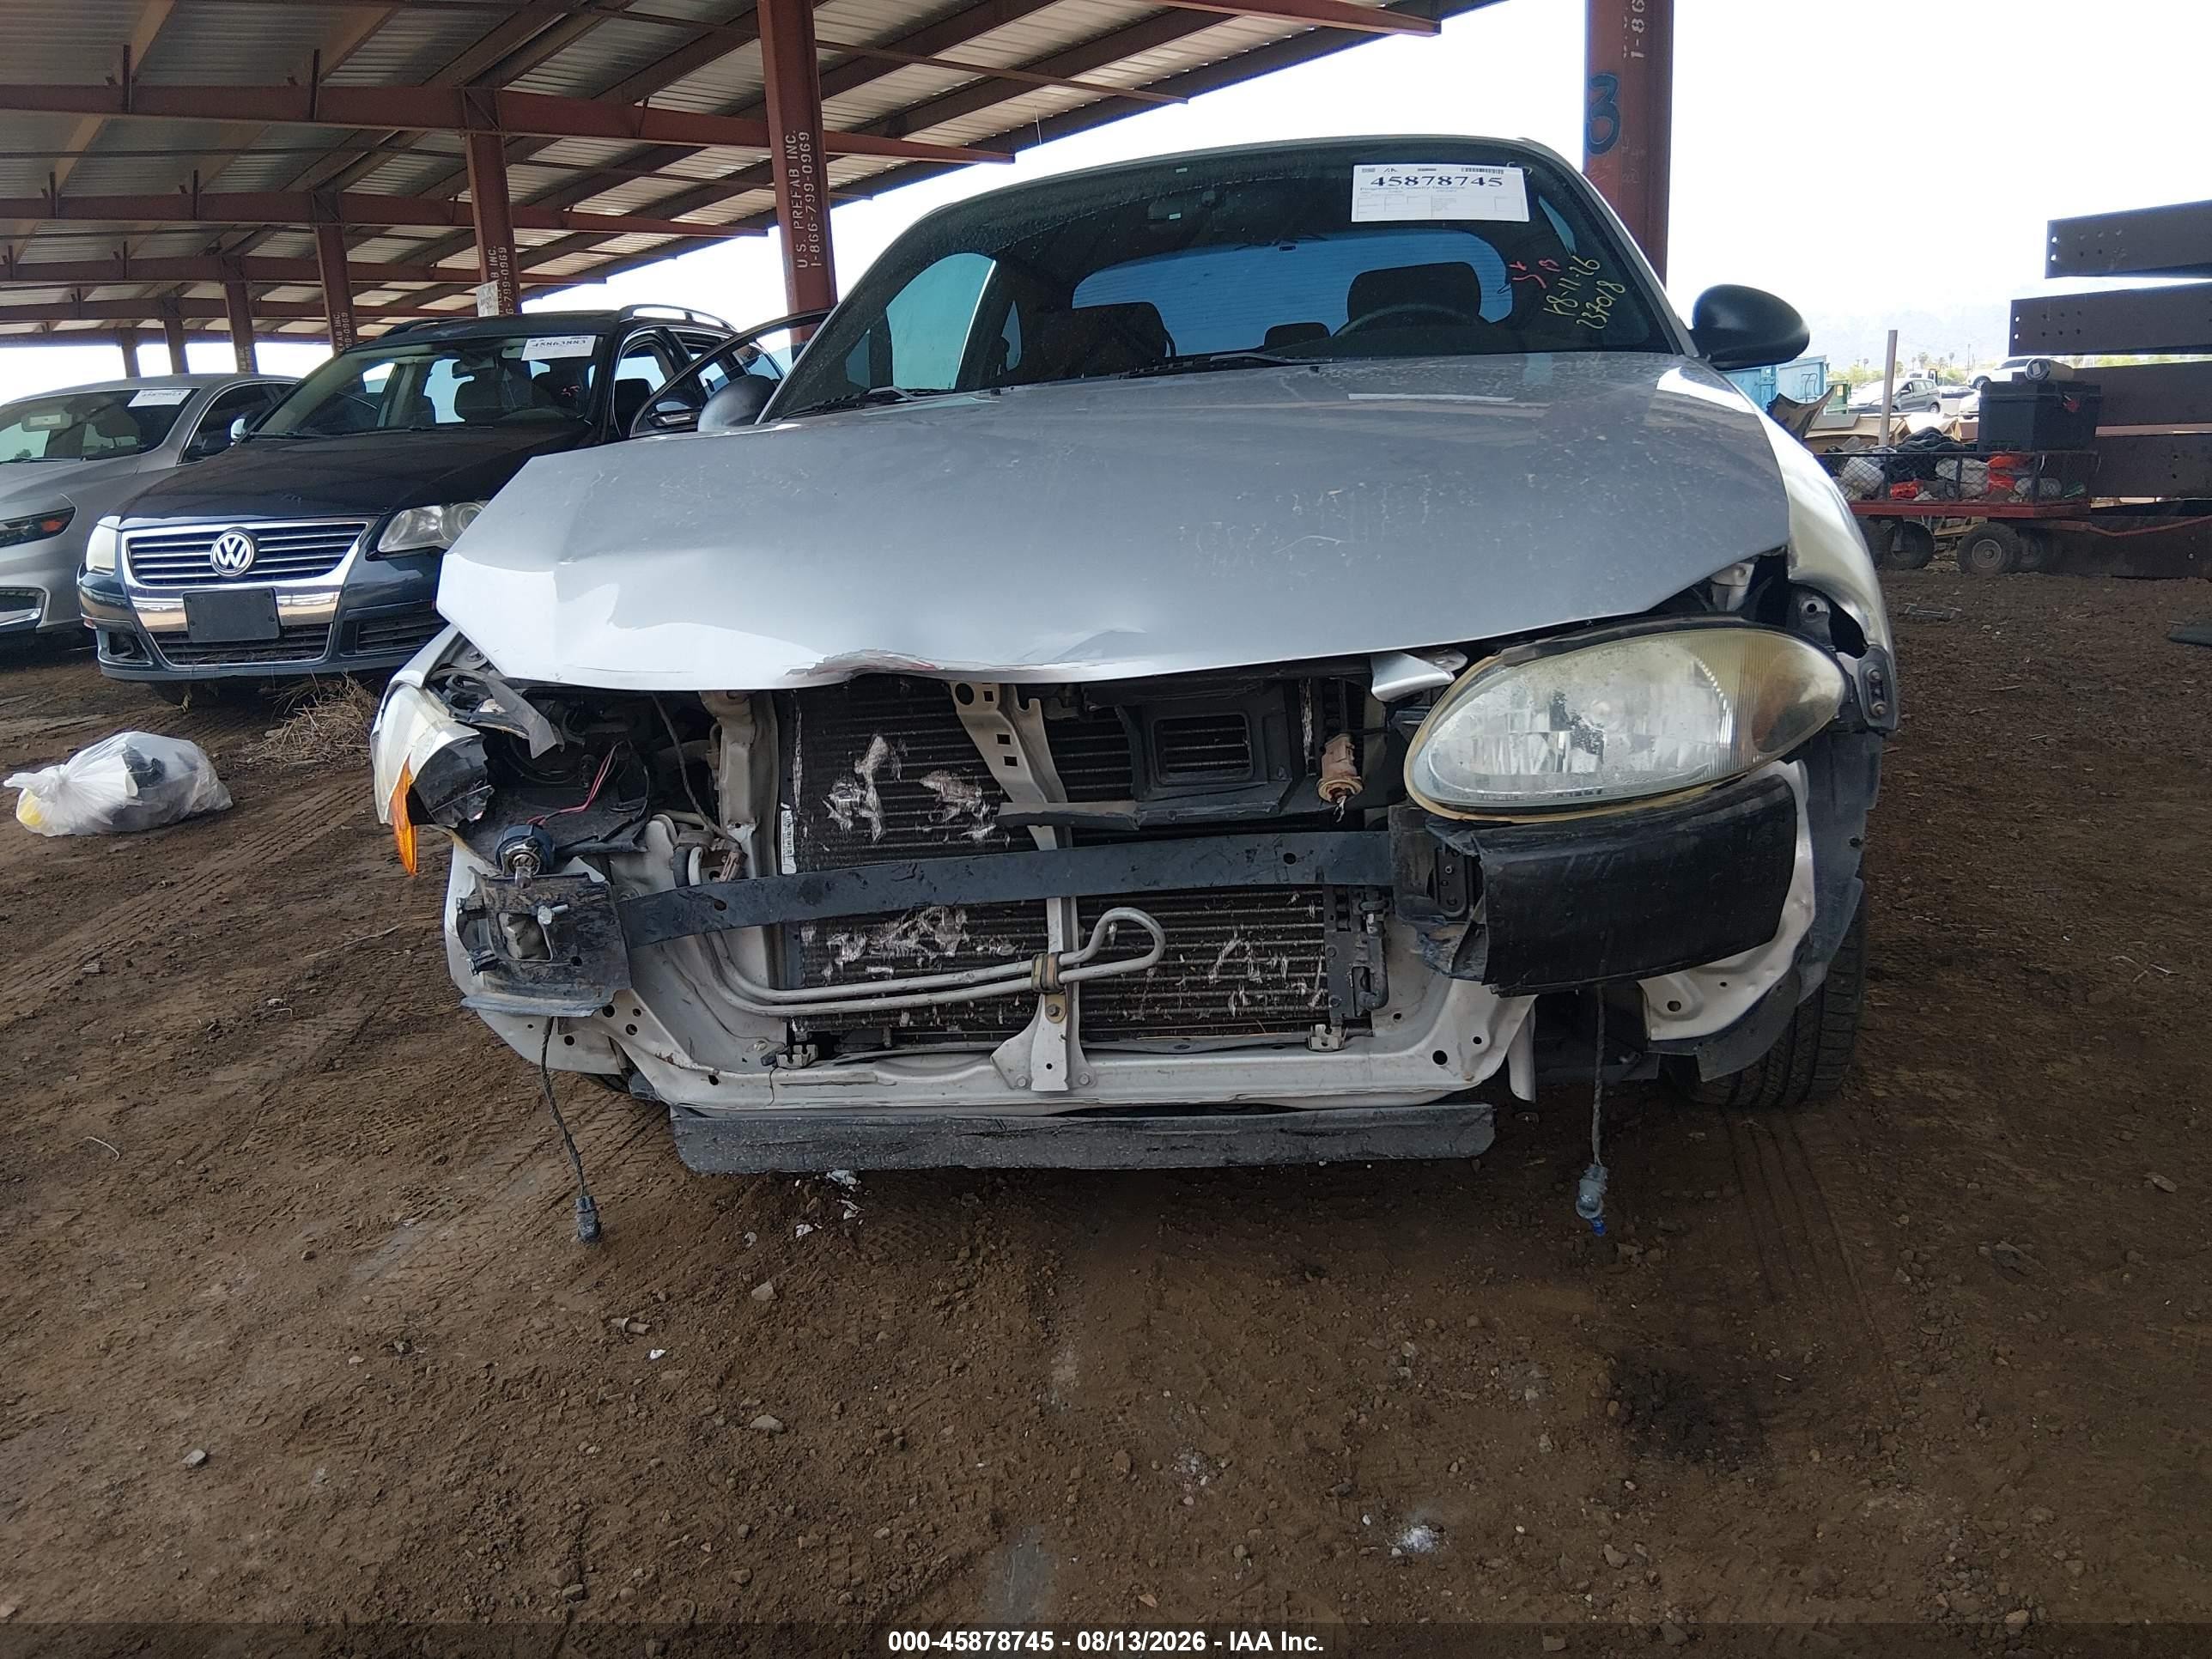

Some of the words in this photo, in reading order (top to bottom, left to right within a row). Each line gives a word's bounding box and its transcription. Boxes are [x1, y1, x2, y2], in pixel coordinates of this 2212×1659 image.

[785, 130, 799, 160] INC.
[788, 168, 805, 229] PREFAB
[799, 131, 823, 267] 1-866-799-0969
[1370, 175, 1504, 187] 45878745
